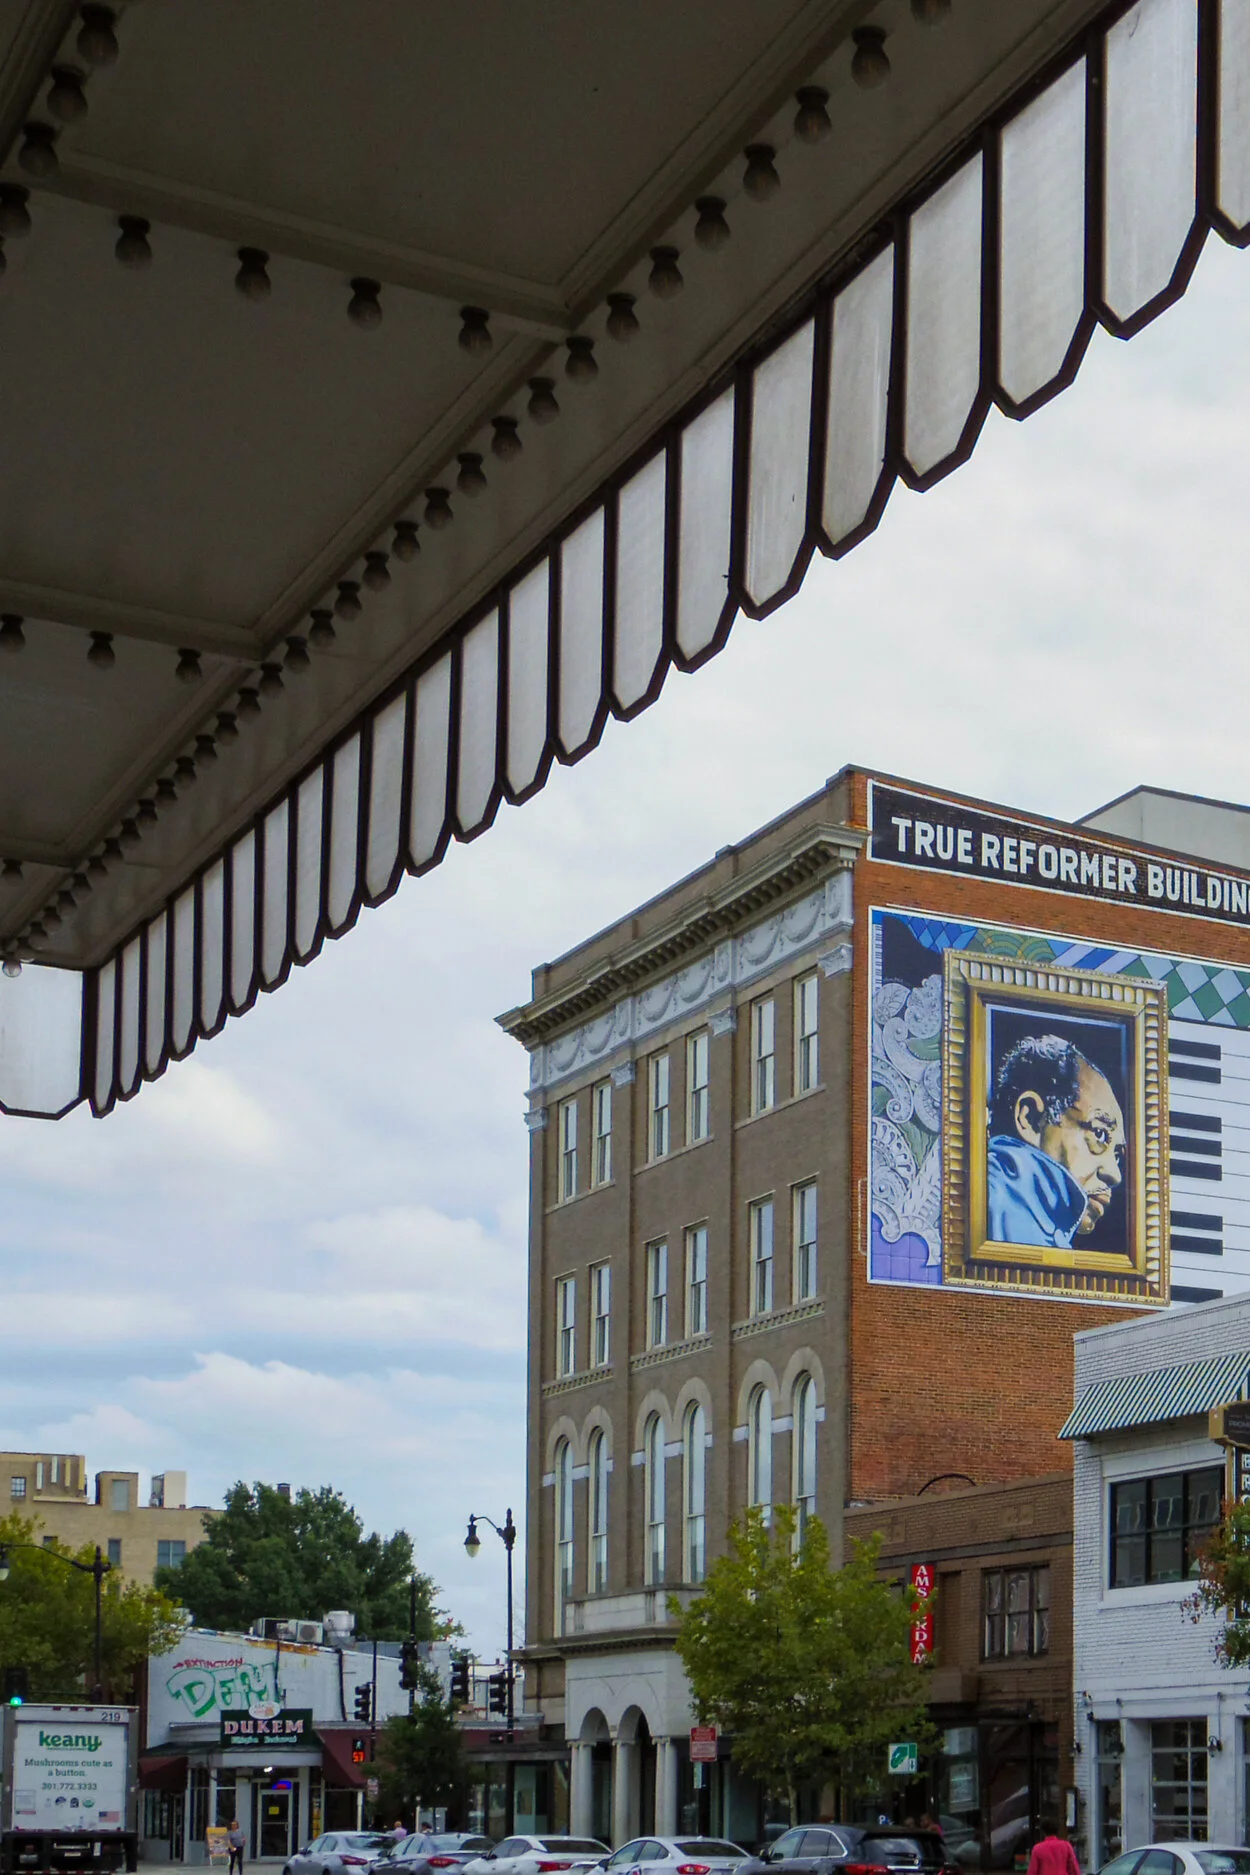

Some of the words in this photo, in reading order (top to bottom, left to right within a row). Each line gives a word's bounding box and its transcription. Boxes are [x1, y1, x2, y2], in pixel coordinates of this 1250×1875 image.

[891, 816, 974, 864] TRUE
[981, 832, 1138, 894] REFORMER
[914, 1565, 929, 1665] AMSRDAM
[101, 1711, 121, 1721] 219
[224, 1719, 304, 1735] DUKEM
[39, 1730, 102, 1752] keany
[24, 1758, 79, 1767] Mushrooms
[81, 1759, 101, 1767] cute
